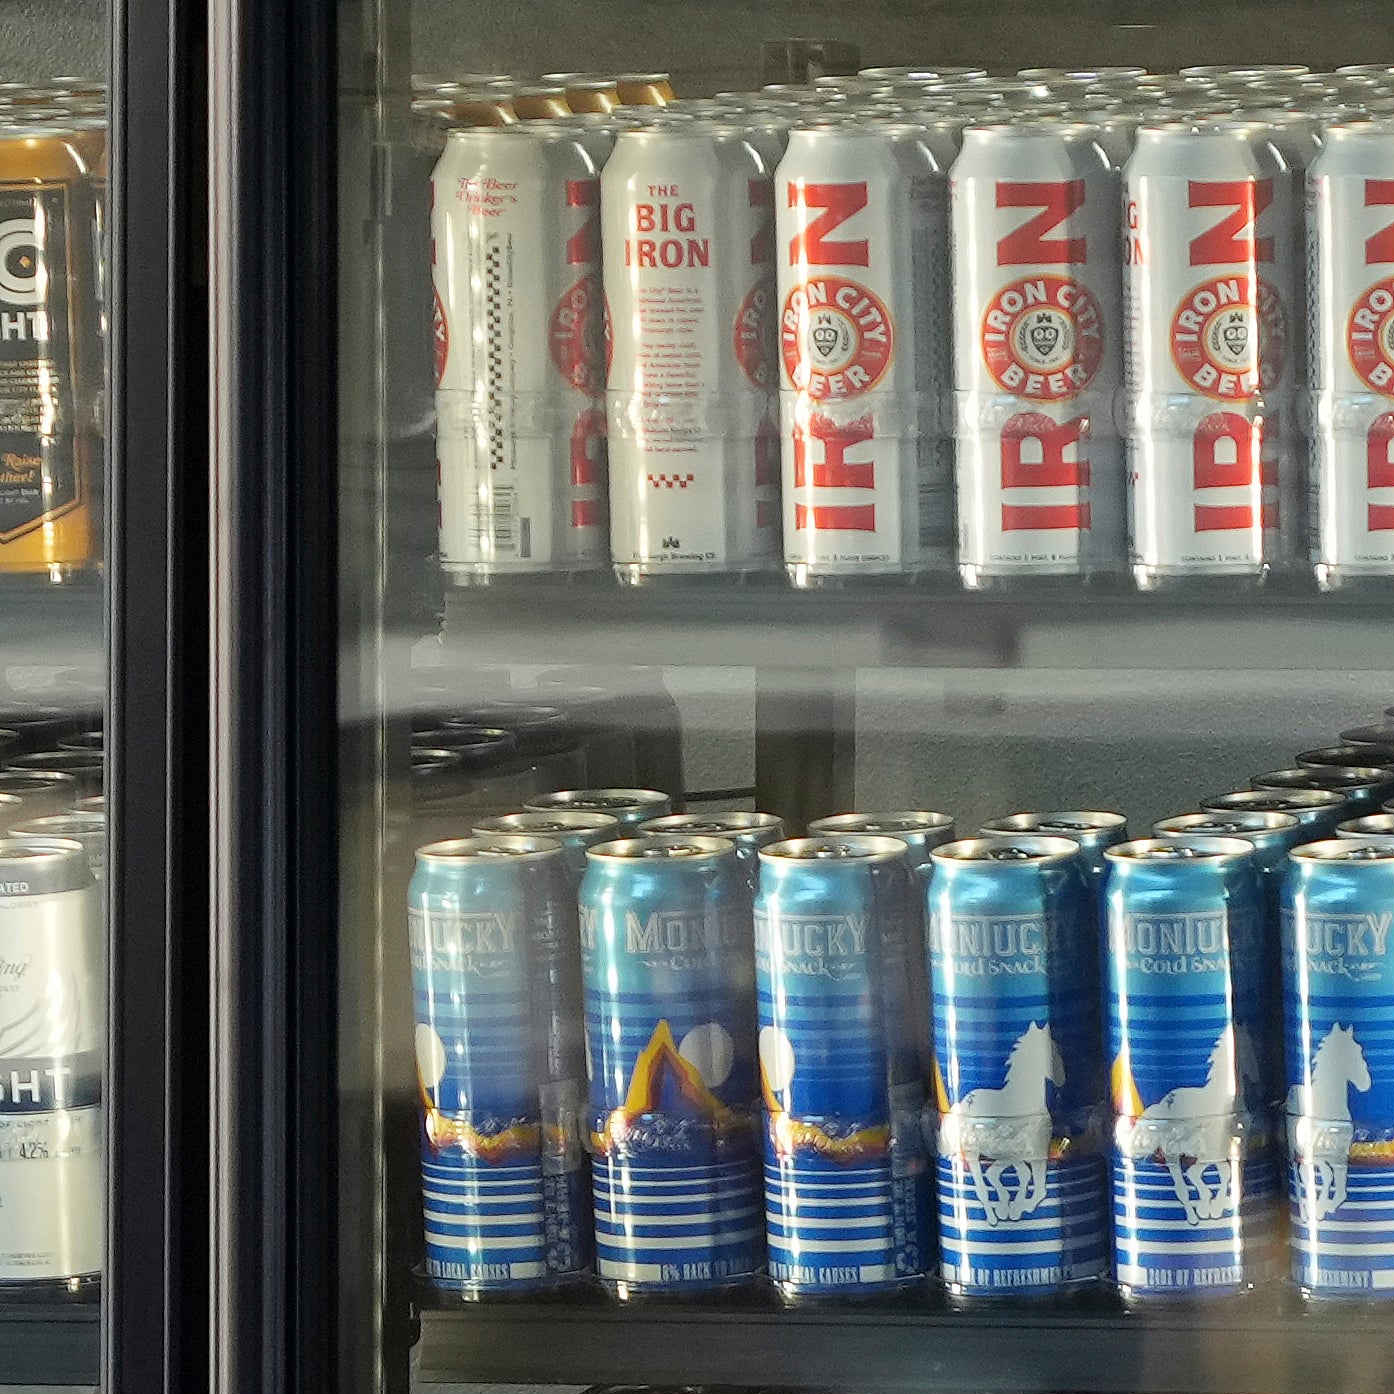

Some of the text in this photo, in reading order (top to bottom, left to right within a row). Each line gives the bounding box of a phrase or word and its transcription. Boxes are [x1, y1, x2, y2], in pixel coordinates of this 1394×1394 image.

[647, 185, 679, 197] THE
[636, 203, 696, 232] BIG
[625, 239, 710, 268] IRON
[835, 283, 887, 346] CITY
[986, 280, 1048, 342] IRON
[1175, 280, 1242, 342] IRON
[1000, 361, 1088, 395] BEER
